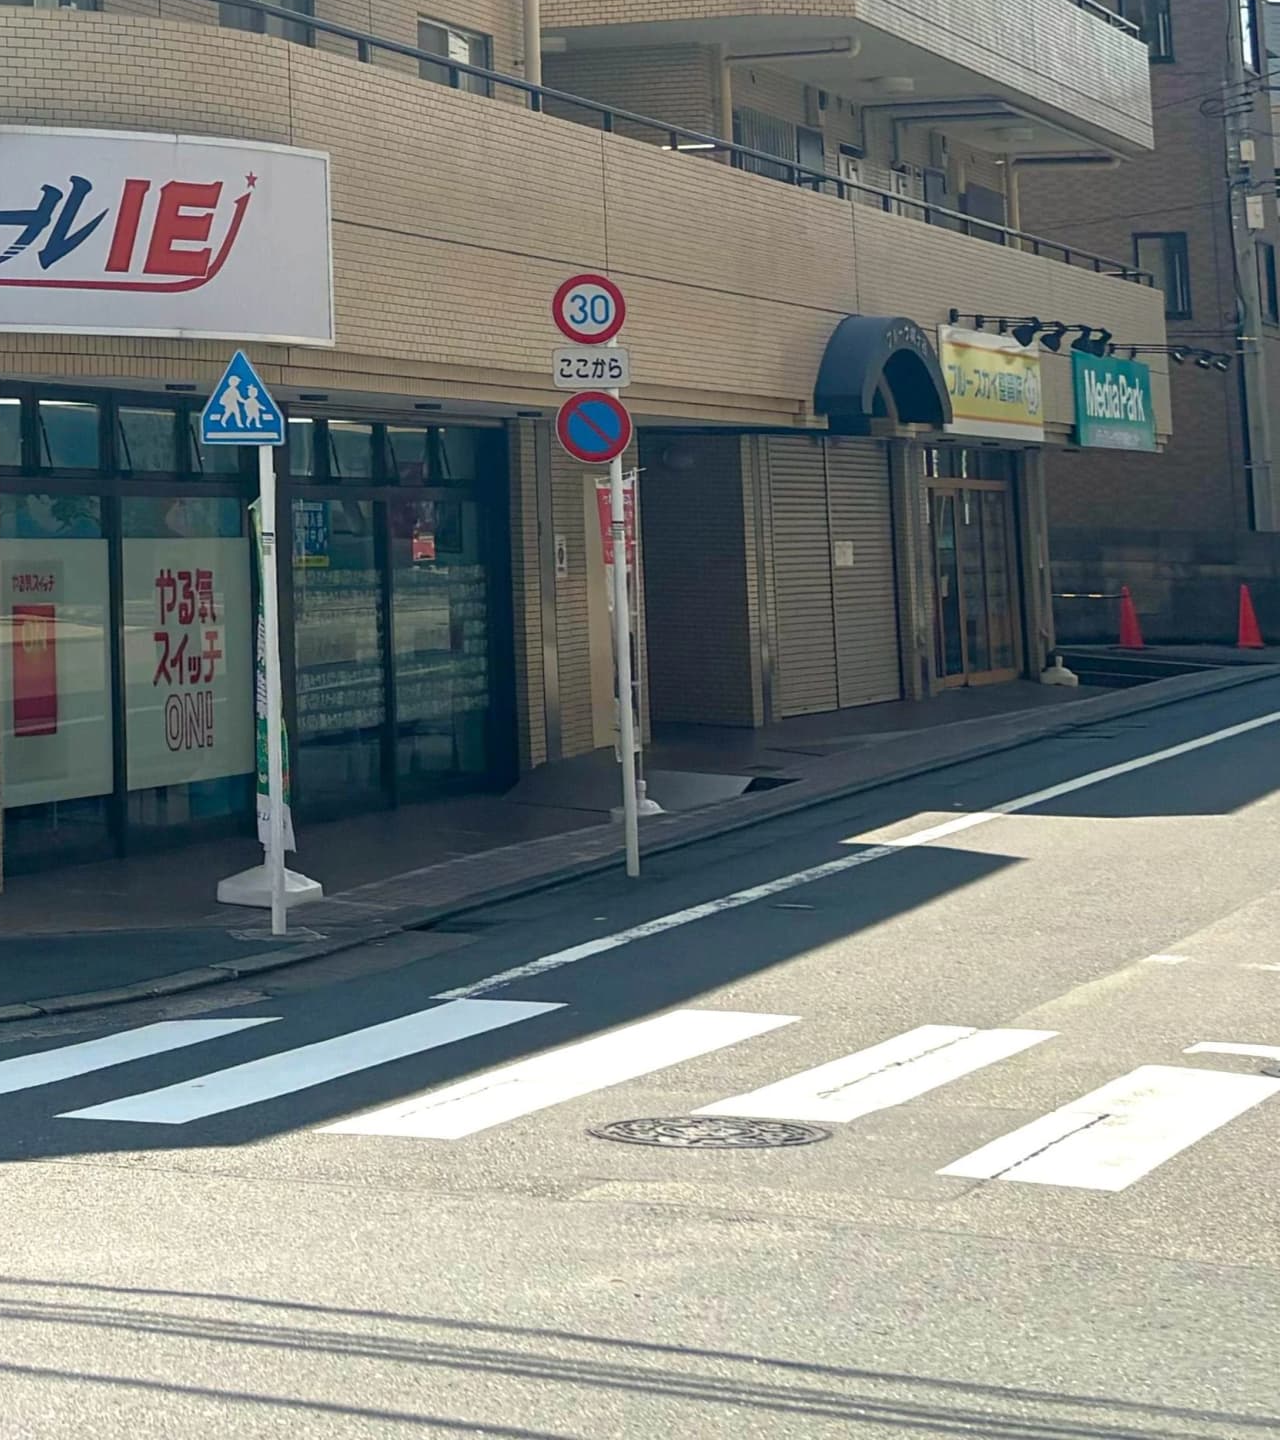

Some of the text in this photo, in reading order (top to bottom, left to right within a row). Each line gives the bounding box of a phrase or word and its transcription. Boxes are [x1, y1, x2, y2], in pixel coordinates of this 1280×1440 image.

[570, 294, 610, 325] 30
[559, 357, 623, 379] ここから
[11, 573, 56, 593] やる気スイッチ
[155, 568, 217, 626] やる気
[153, 630, 223, 687] スイッチ
[165, 691, 214, 752] ON!
